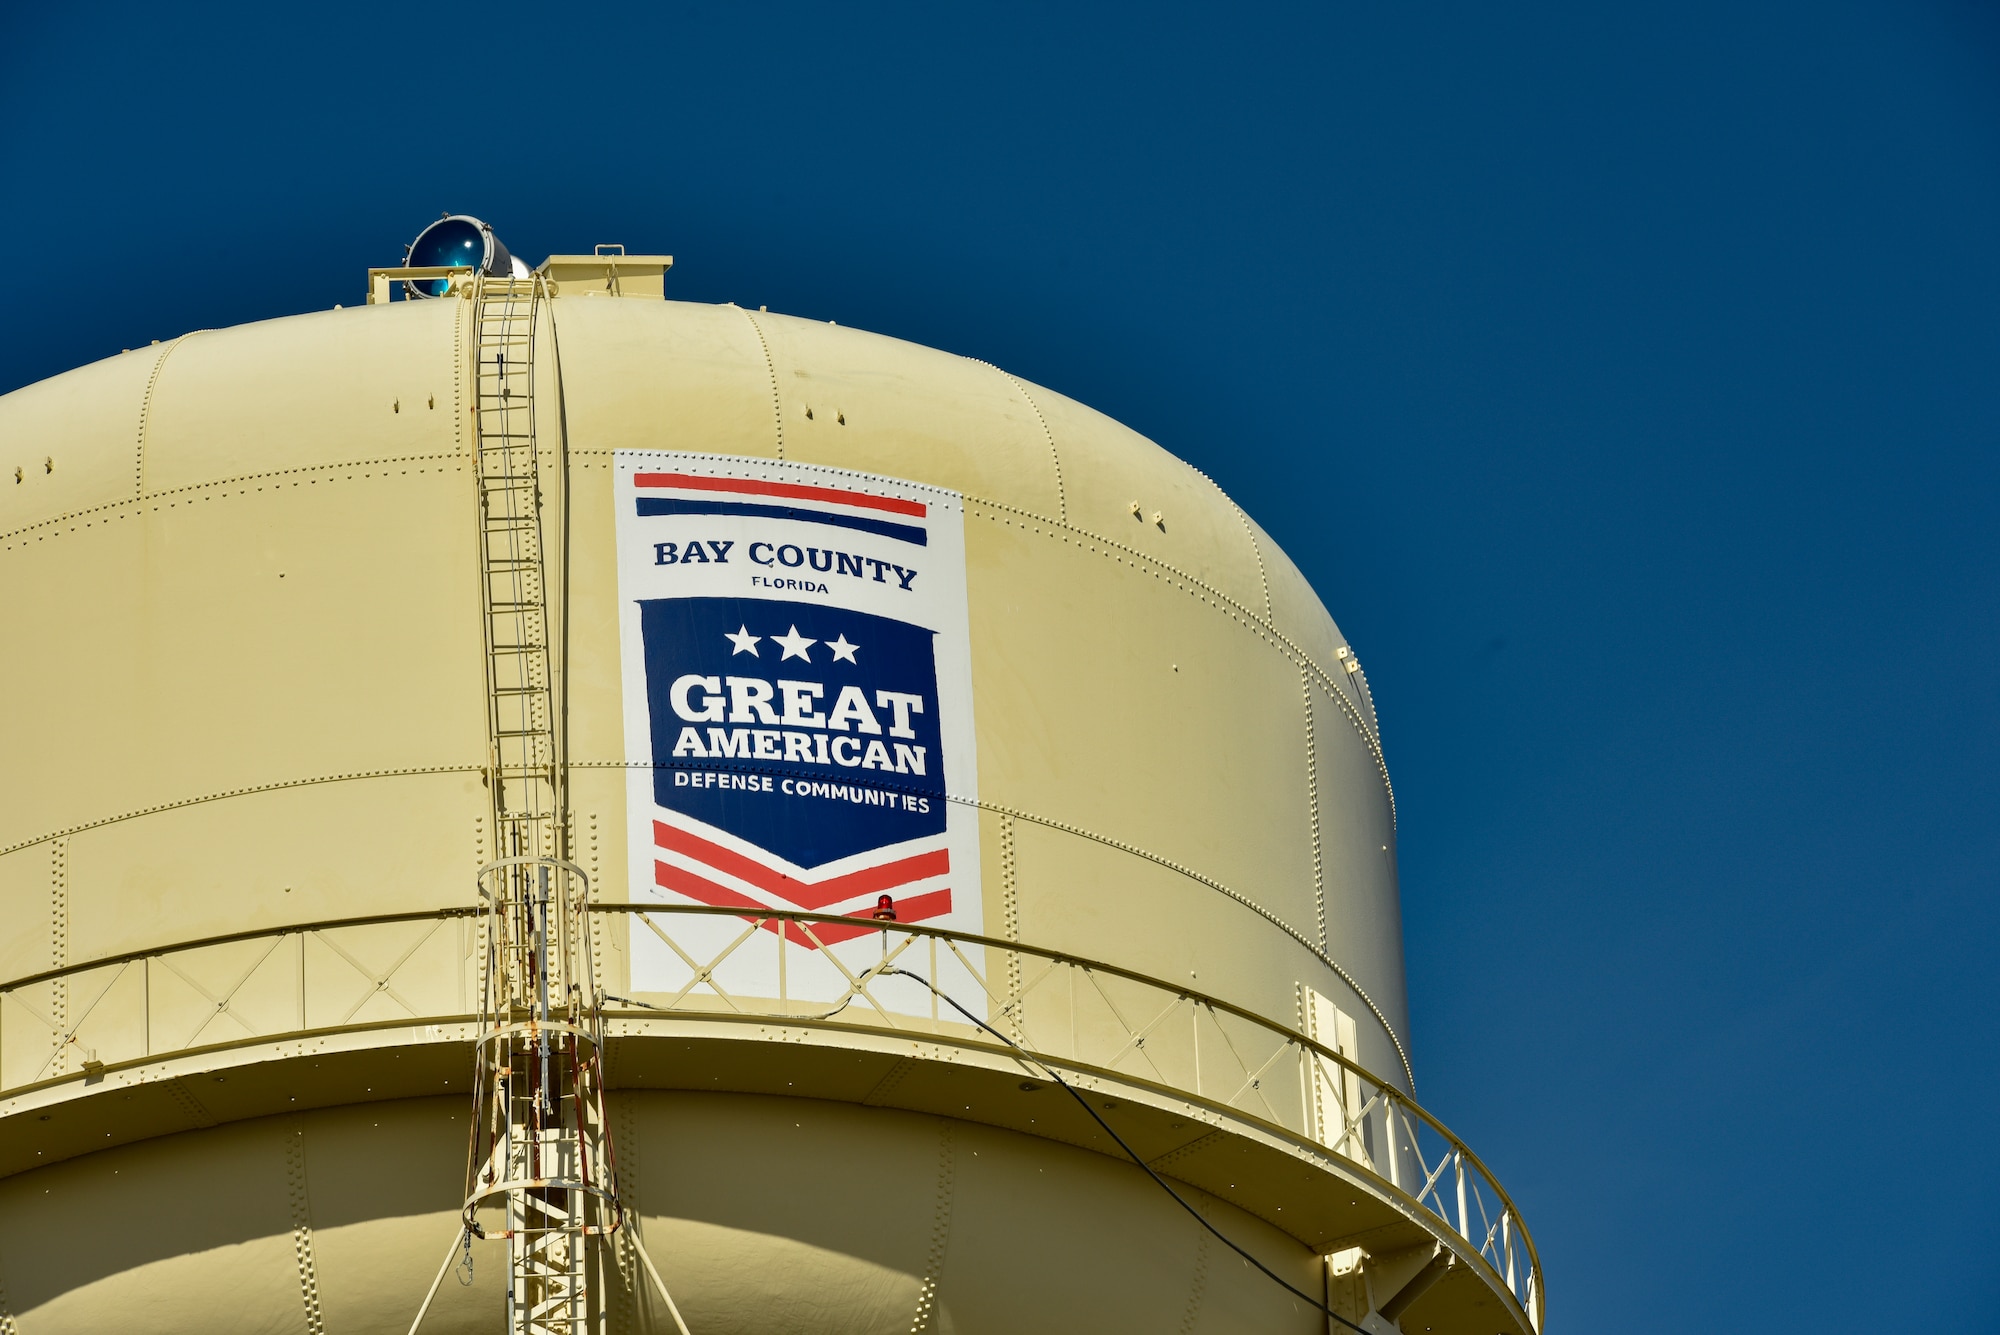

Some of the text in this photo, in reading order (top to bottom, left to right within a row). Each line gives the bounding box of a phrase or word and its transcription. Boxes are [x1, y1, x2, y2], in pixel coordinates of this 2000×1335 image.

[654, 541, 917, 591] BAY COUNTY
[752, 576, 828, 593] FLORIDA
[669, 674, 924, 740] GREAT
[672, 726, 927, 777] AMERICAN
[674, 772, 929, 813] DEFENSE COMMUNITIES
